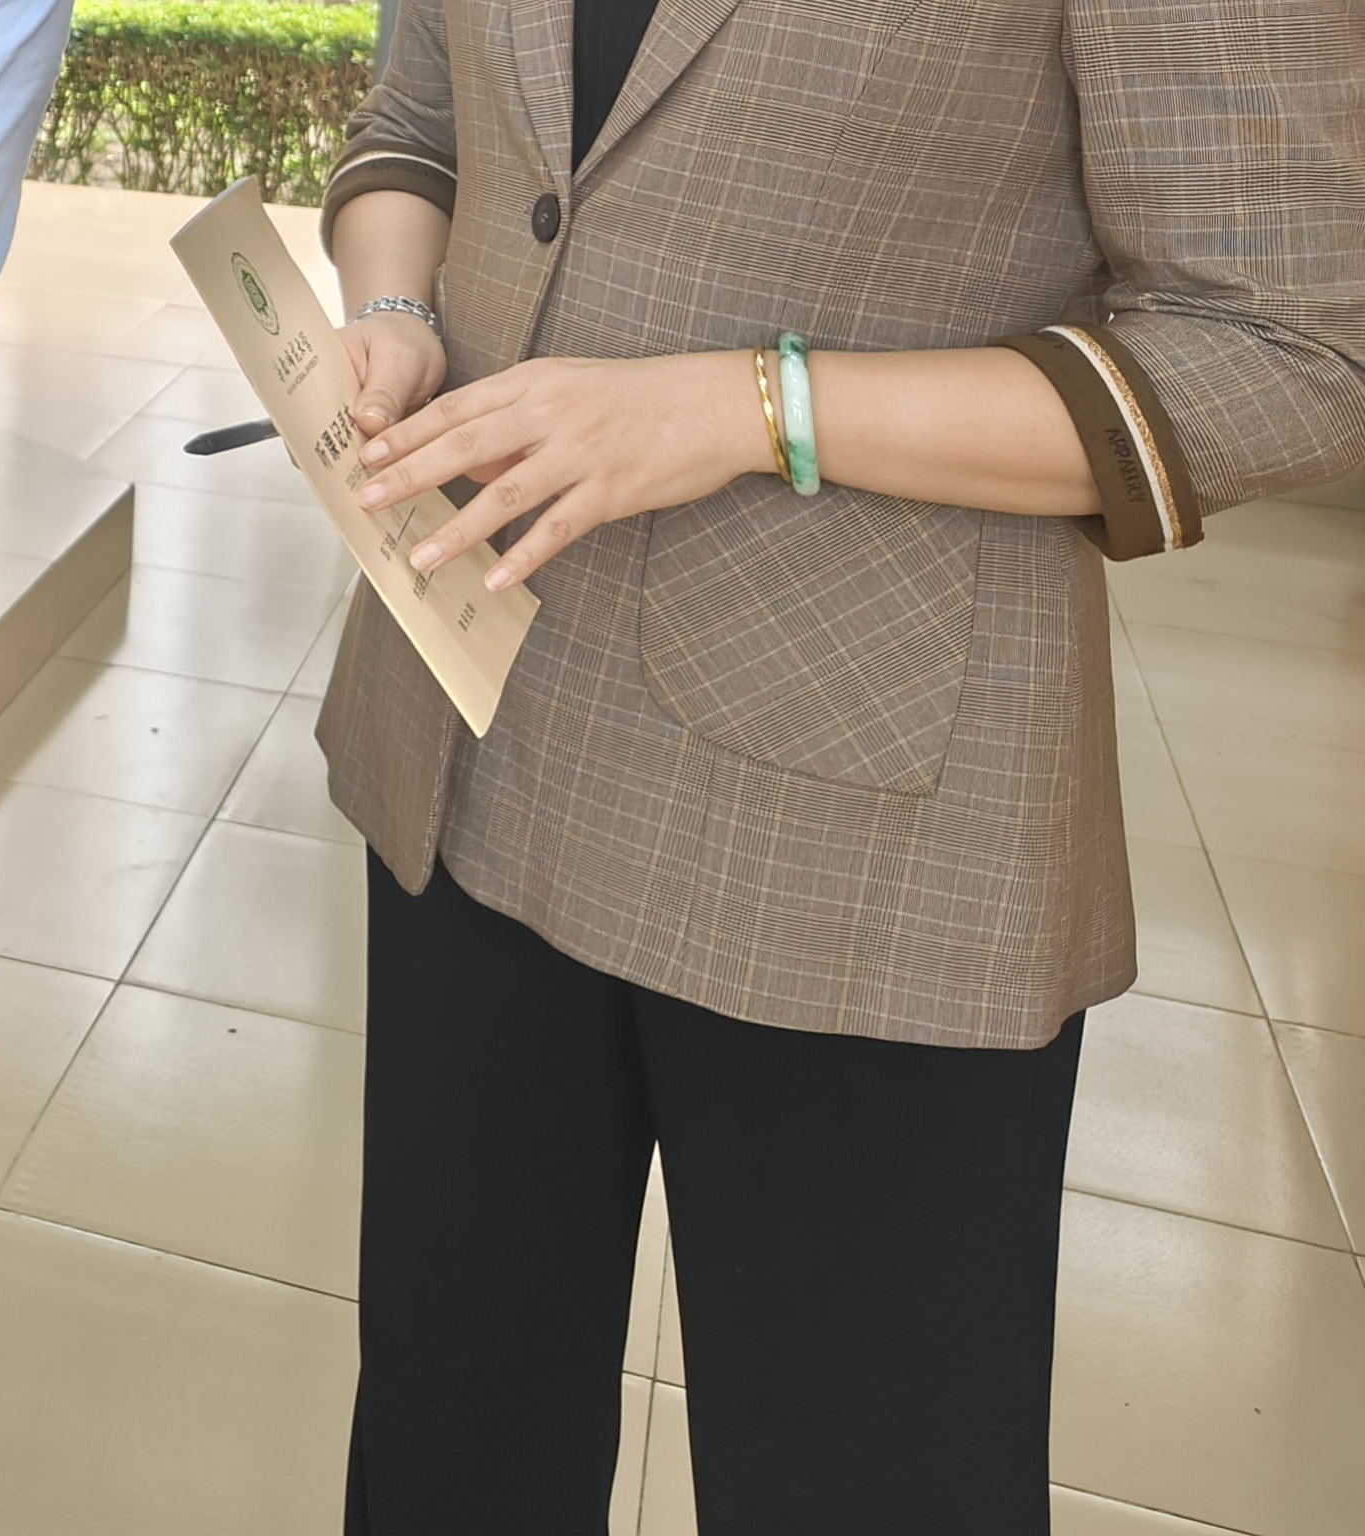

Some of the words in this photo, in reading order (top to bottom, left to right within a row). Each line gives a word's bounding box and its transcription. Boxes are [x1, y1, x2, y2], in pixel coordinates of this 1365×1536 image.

[314, 402, 357, 472] 听课记录本
